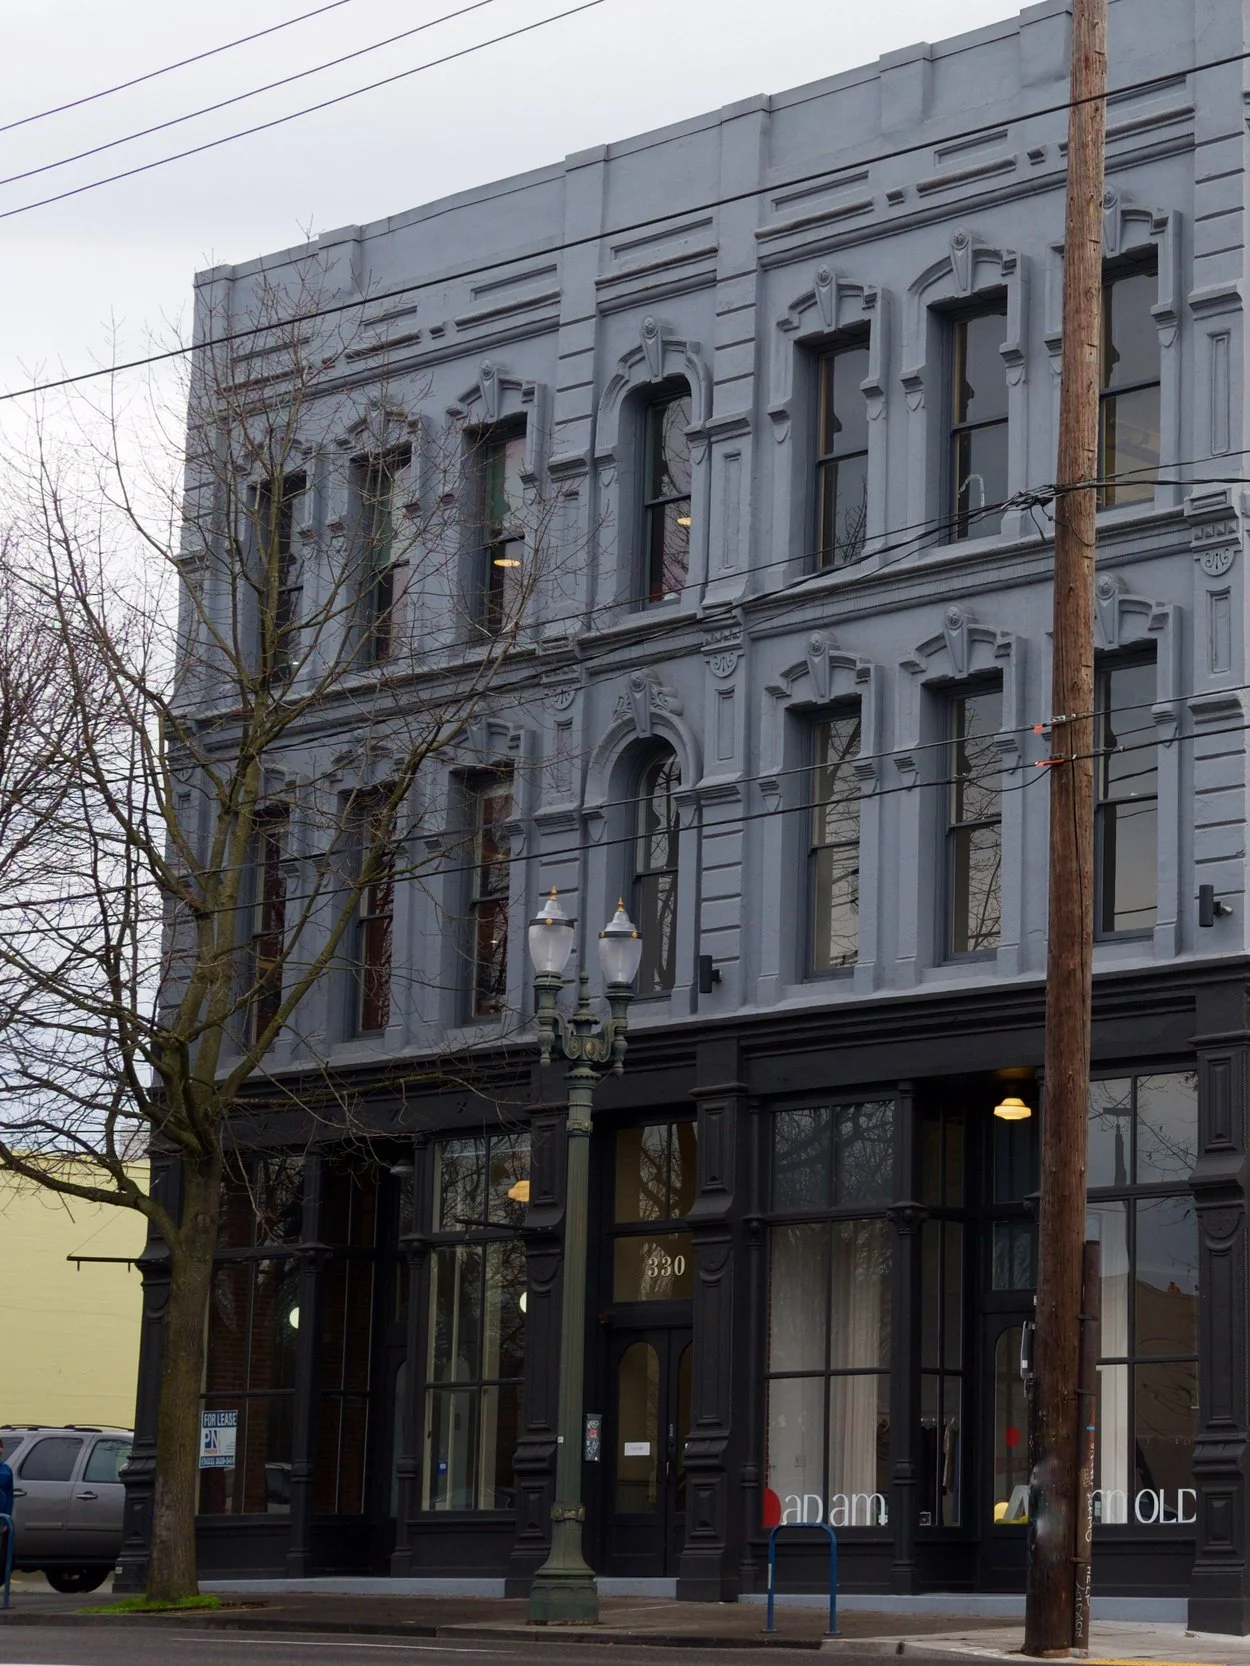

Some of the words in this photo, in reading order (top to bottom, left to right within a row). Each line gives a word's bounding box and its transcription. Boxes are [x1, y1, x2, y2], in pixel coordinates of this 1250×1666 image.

[648, 1255, 686, 1278] 330
[203, 1413, 217, 1427] FOR
[217, 1412, 237, 1426] LEASE
